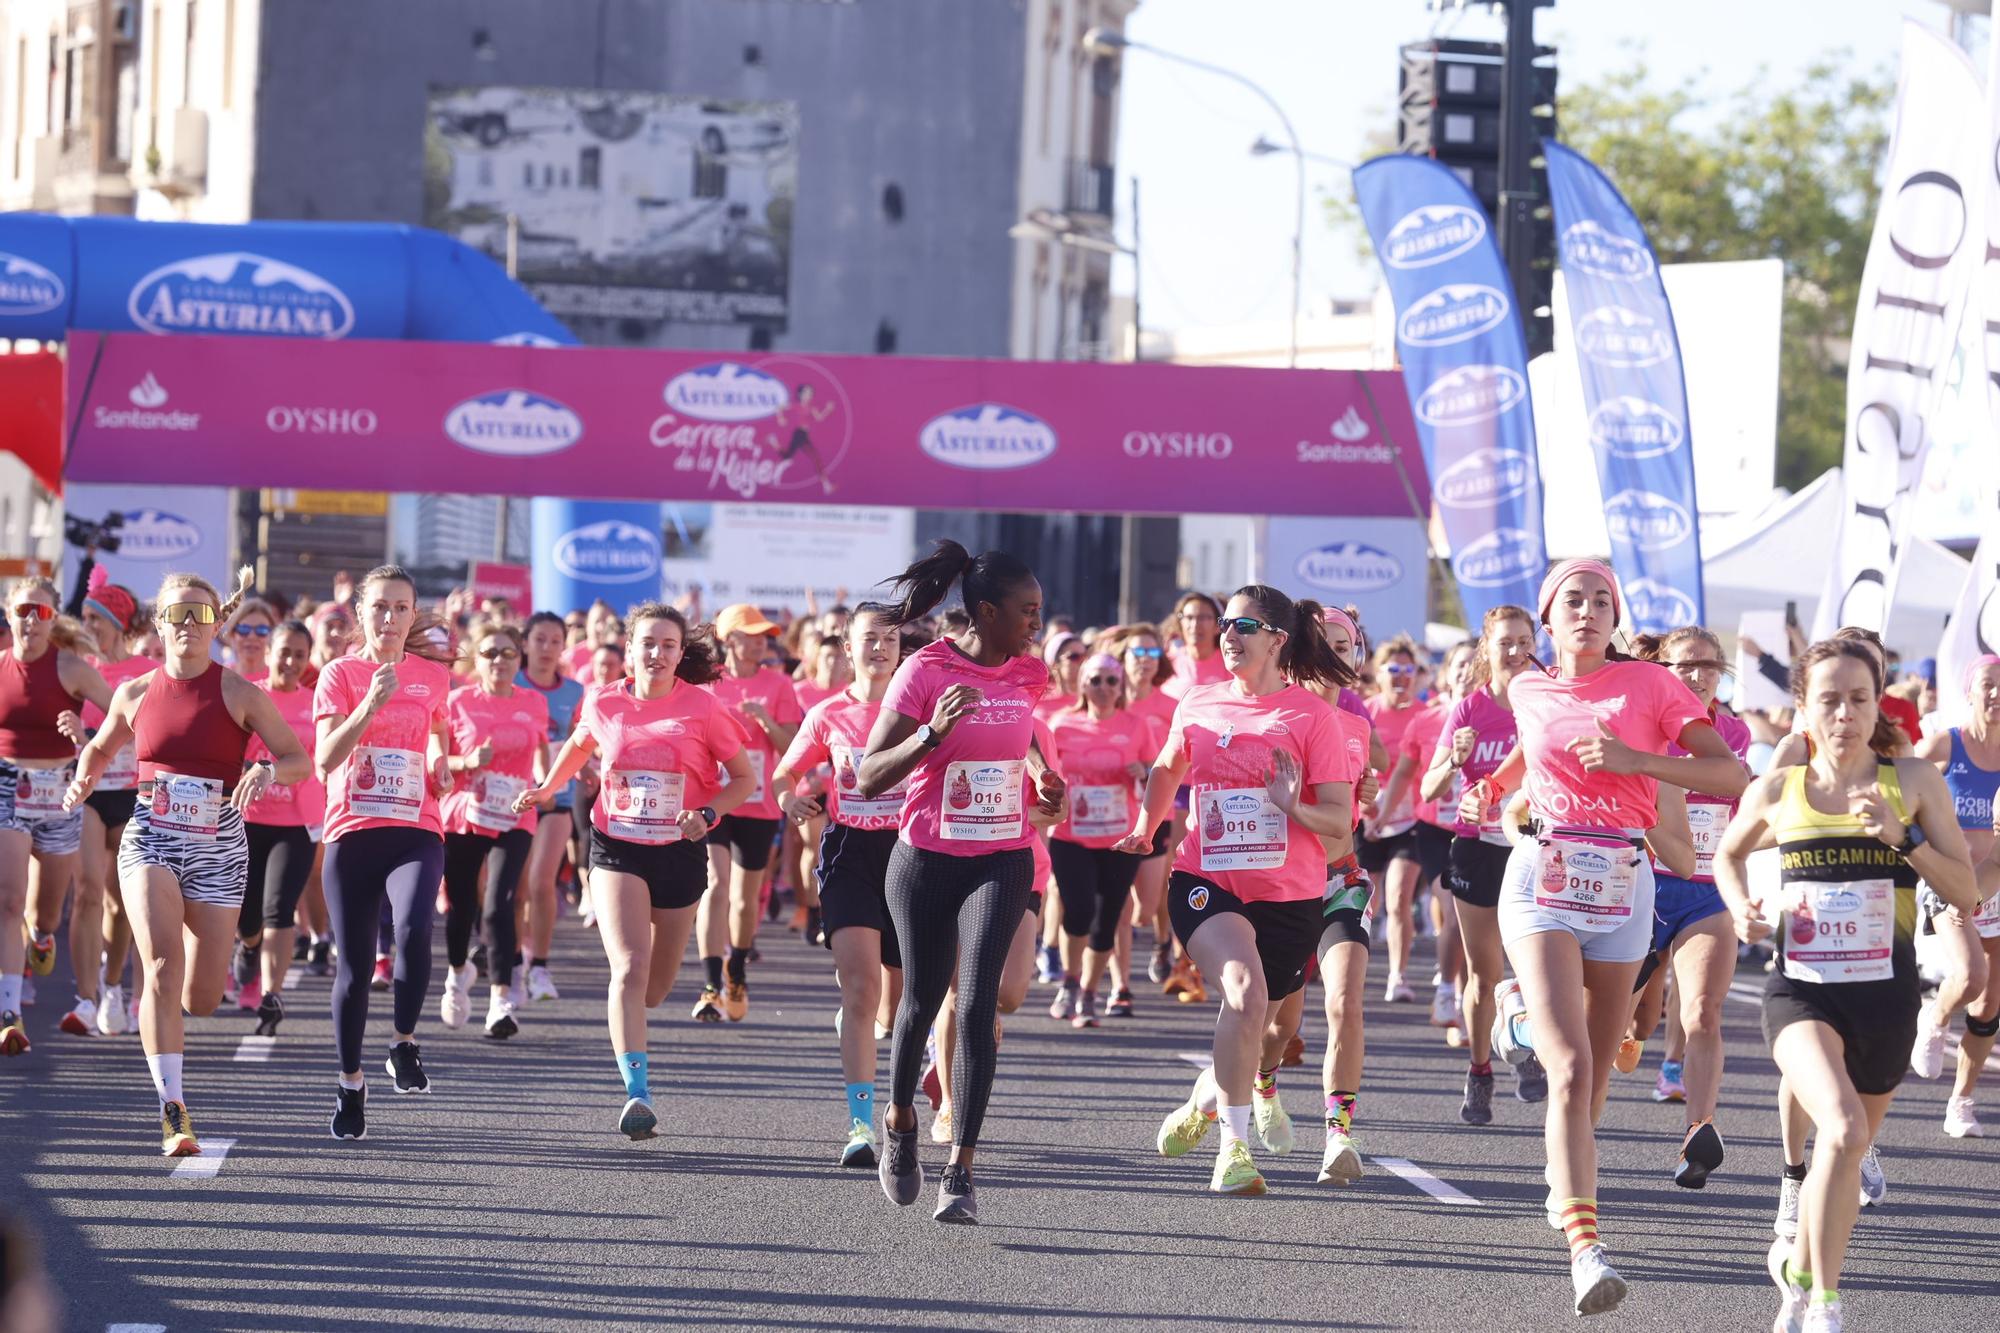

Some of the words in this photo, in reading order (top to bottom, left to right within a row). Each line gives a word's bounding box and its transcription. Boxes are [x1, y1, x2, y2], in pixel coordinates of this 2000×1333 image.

[146, 282, 335, 333] ASTURIANA
[95, 406, 199, 430] Santander
[266, 406, 378, 434] OYSHO
[457, 414, 571, 438] ASTURIANA
[650, 413, 755, 448] Carrera
[930, 421, 1045, 453] ASTURIANA
[1123, 431, 1233, 459] OYSHO
[707, 445, 793, 498] Mujer
[1305, 557, 1395, 581] ASTURIANA
[378, 775, 404, 787] 016
[382, 787, 399, 795] 4243
[633, 797, 657, 808] 016
[974, 792, 1002, 804] 016
[172, 802, 198, 814] 016
[981, 806, 995, 814] 350
[1225, 803, 1258, 811] ASTURIANA
[176, 815, 192, 823] 3531
[1226, 820, 1257, 832] 016
[1240, 834, 1244, 842] 1
[1691, 832, 1710, 842] 16
[1208, 857, 1233, 866] OYSHO
[1571, 858, 1608, 870] ASTURIANA
[1570, 877, 1603, 893] 016
[1574, 892, 1596, 902] 4266
[1545, 900, 1571, 910] CARRERA
[1820, 921, 1857, 935] 016
[1833, 939, 1844, 947] 11
